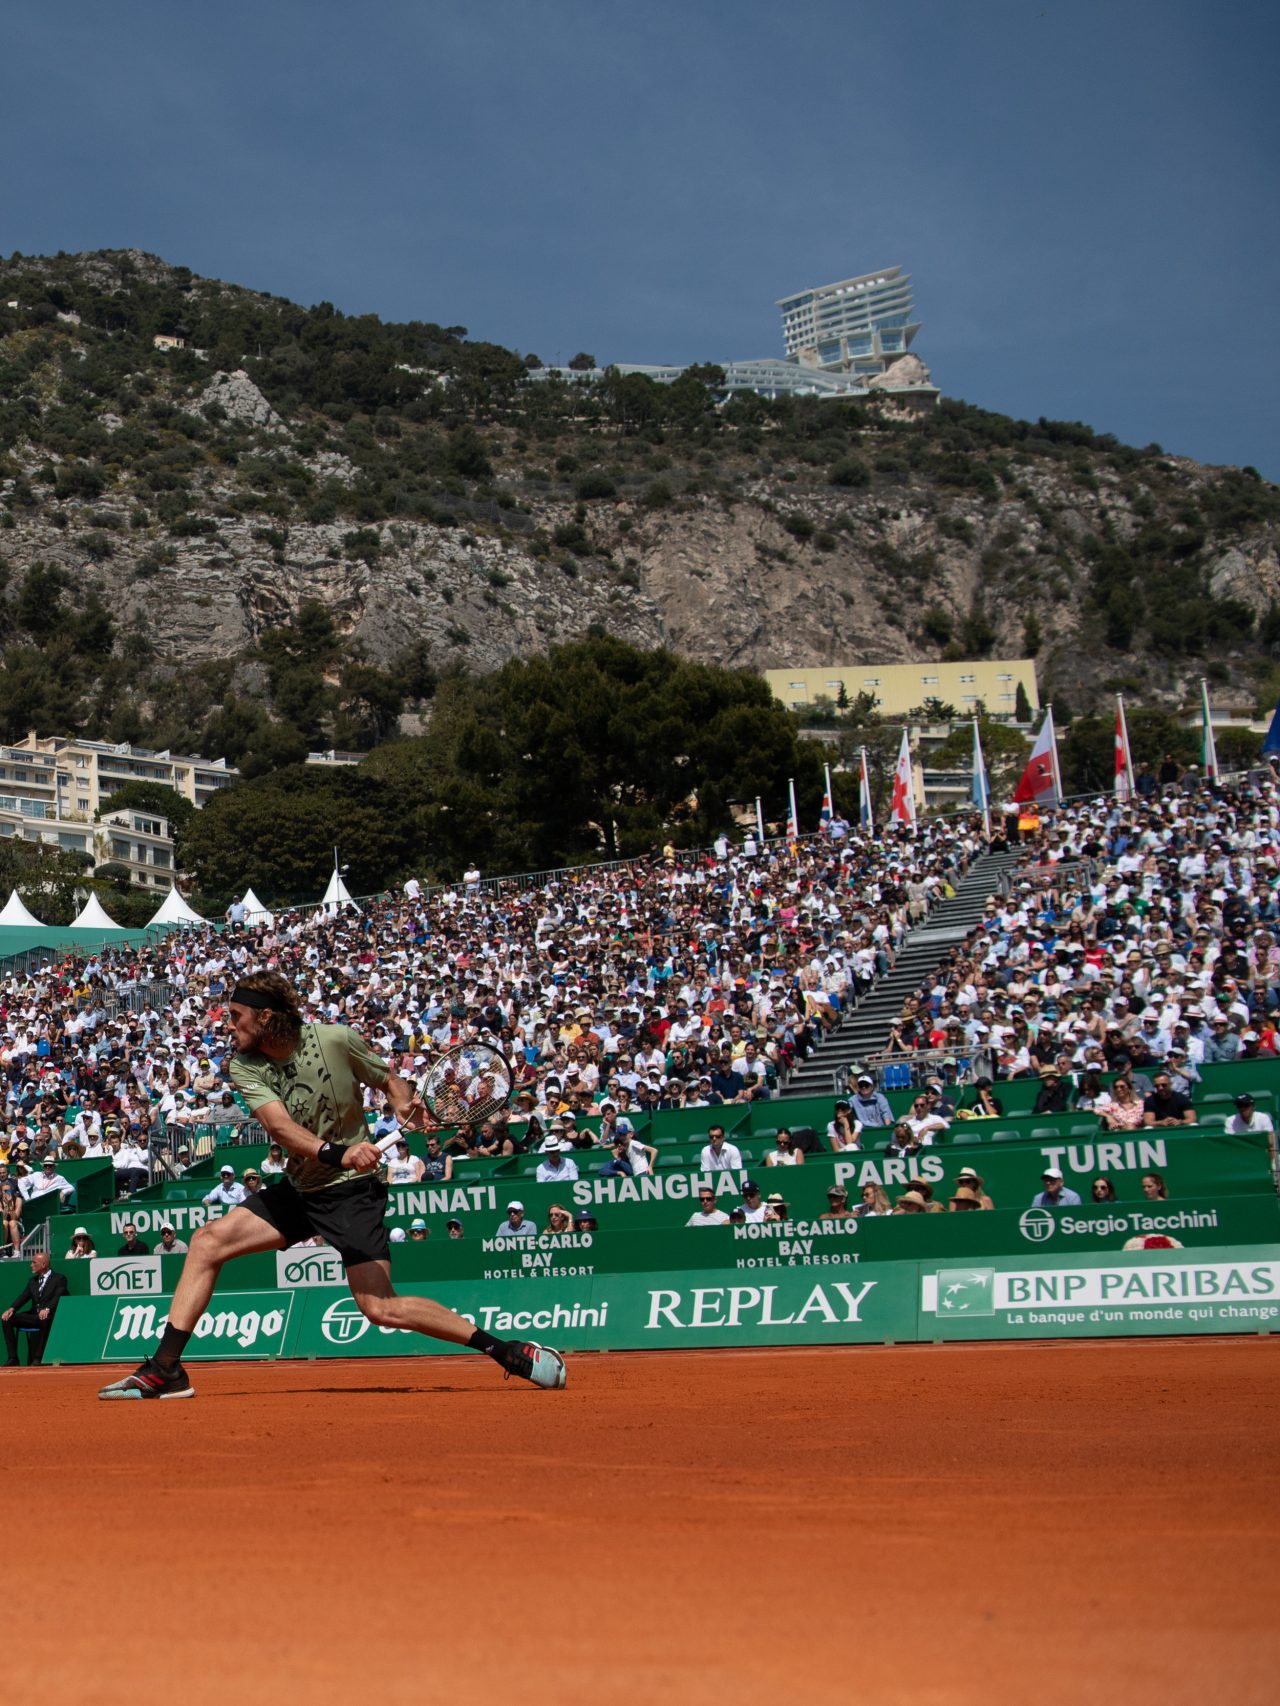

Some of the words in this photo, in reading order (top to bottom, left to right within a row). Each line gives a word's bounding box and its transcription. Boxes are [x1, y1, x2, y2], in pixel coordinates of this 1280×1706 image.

[834, 1155, 944, 1187] PARIS
[1040, 1140, 1168, 1173] TURIN
[573, 1169, 748, 1205] SHANGHAI
[110, 1204, 237, 1235] MONTRE
[1061, 1214, 1127, 1236] Sergio
[1128, 1209, 1218, 1231] Tacchini
[521, 1253, 553, 1268] BAY
[736, 1256, 779, 1269] HOTEL
[788, 1255, 796, 1266] &
[803, 1253, 860, 1266] RESORT
[778, 1240, 814, 1256] BAY
[484, 1269, 525, 1280] HOTEL
[530, 1268, 537, 1276] &
[544, 1266, 594, 1277] RESORT
[1007, 1274, 1087, 1303] BNP
[1100, 1267, 1275, 1300] PARIBAS
[479, 1302, 609, 1331] Tacchini
[644, 1281, 878, 1329] REPLAY
[1007, 1313, 1024, 1324] La
[1029, 1311, 1085, 1325] banque
[1090, 1309, 1124, 1322] d'un
[1129, 1307, 1184, 1320] monde
[1188, 1306, 1214, 1321] qui
[1219, 1305, 1279, 1320] change
[113, 1304, 284, 1348] Maongo
